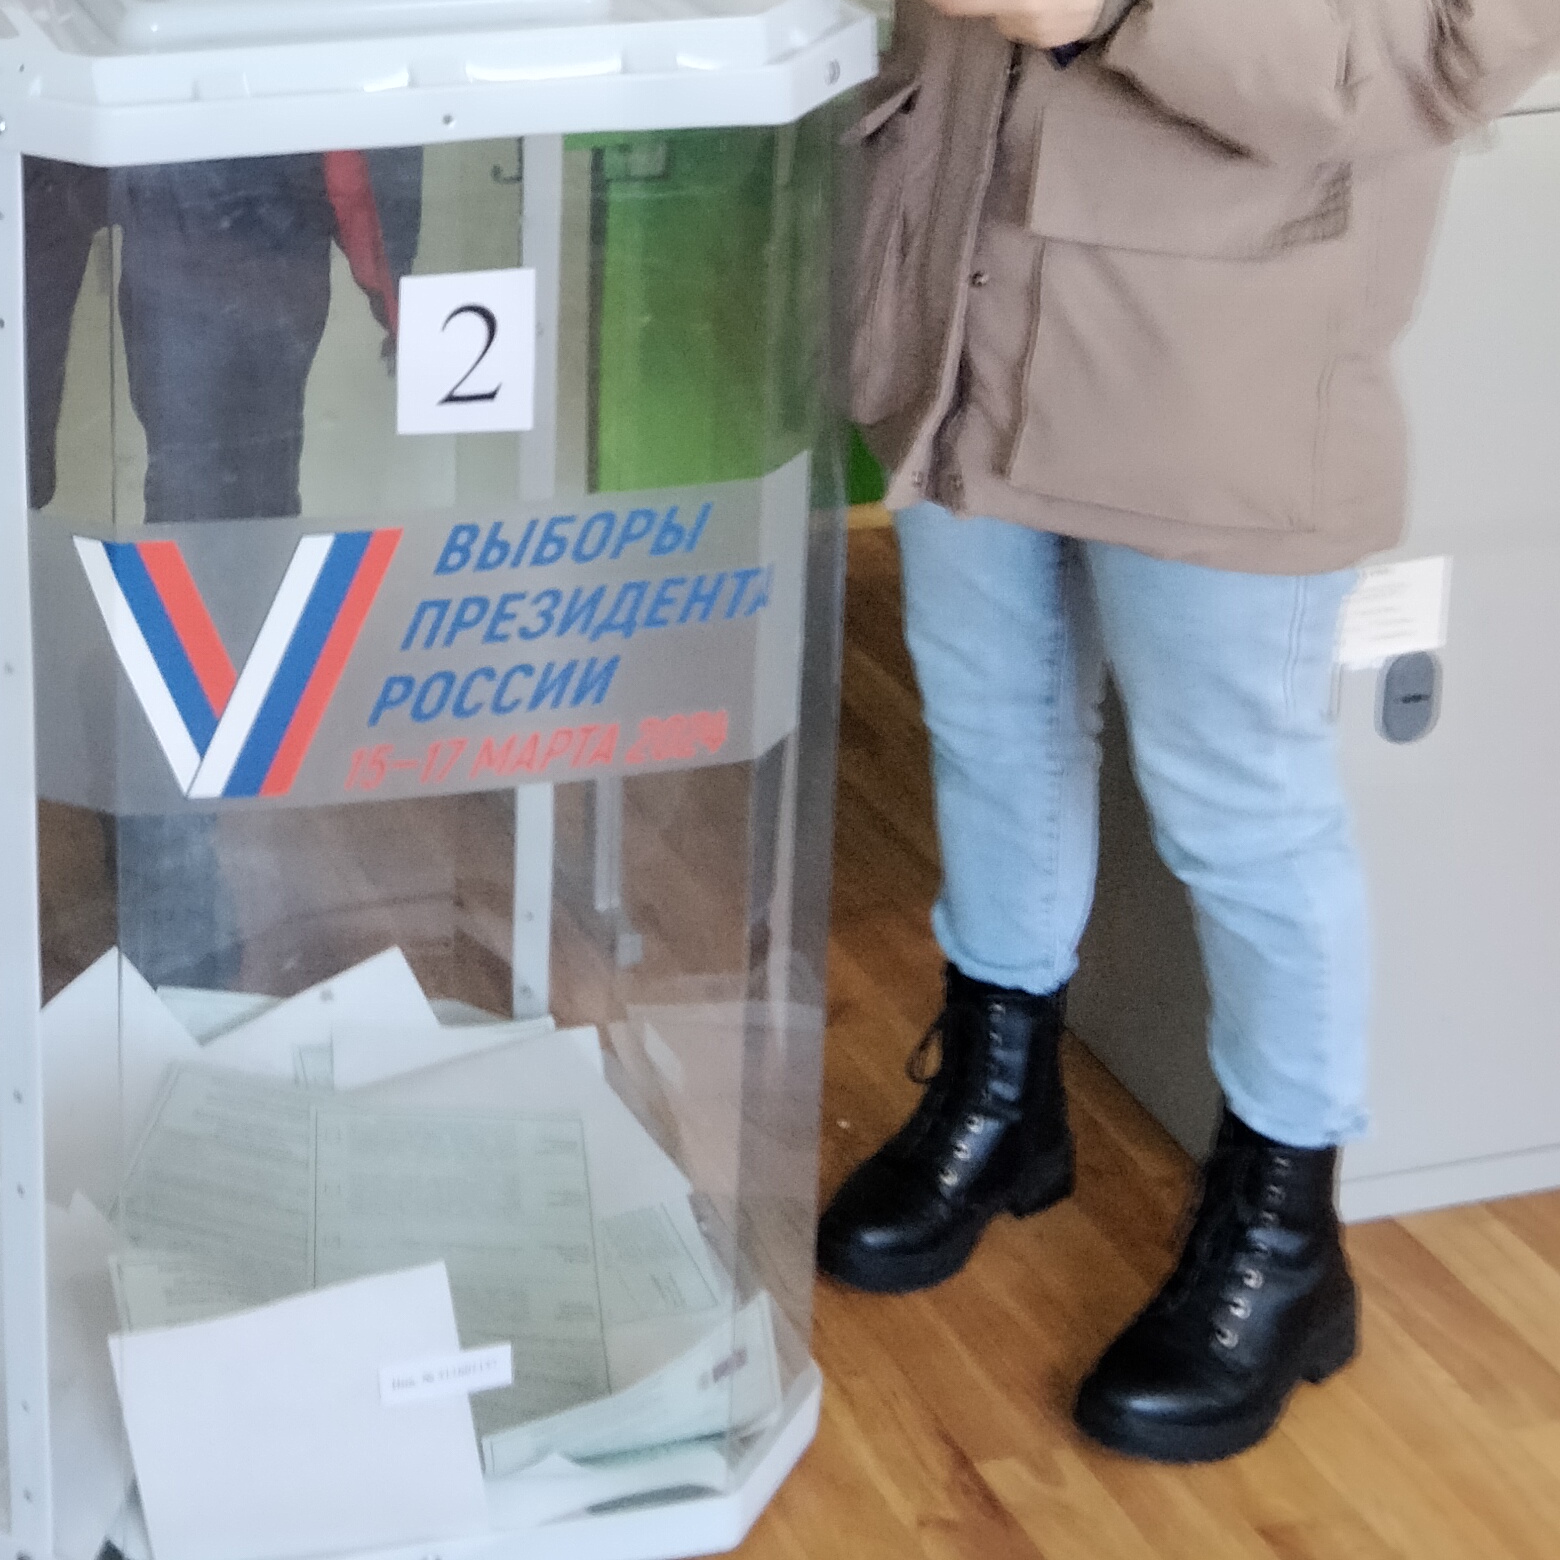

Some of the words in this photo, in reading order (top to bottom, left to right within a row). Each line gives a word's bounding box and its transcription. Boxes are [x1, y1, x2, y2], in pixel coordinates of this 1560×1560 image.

[436, 303, 504, 406] 2
[434, 501, 715, 576] ВЫБОРЫ
[367, 655, 621, 727] РОССИИ
[470, 722, 621, 780] МАРТА
